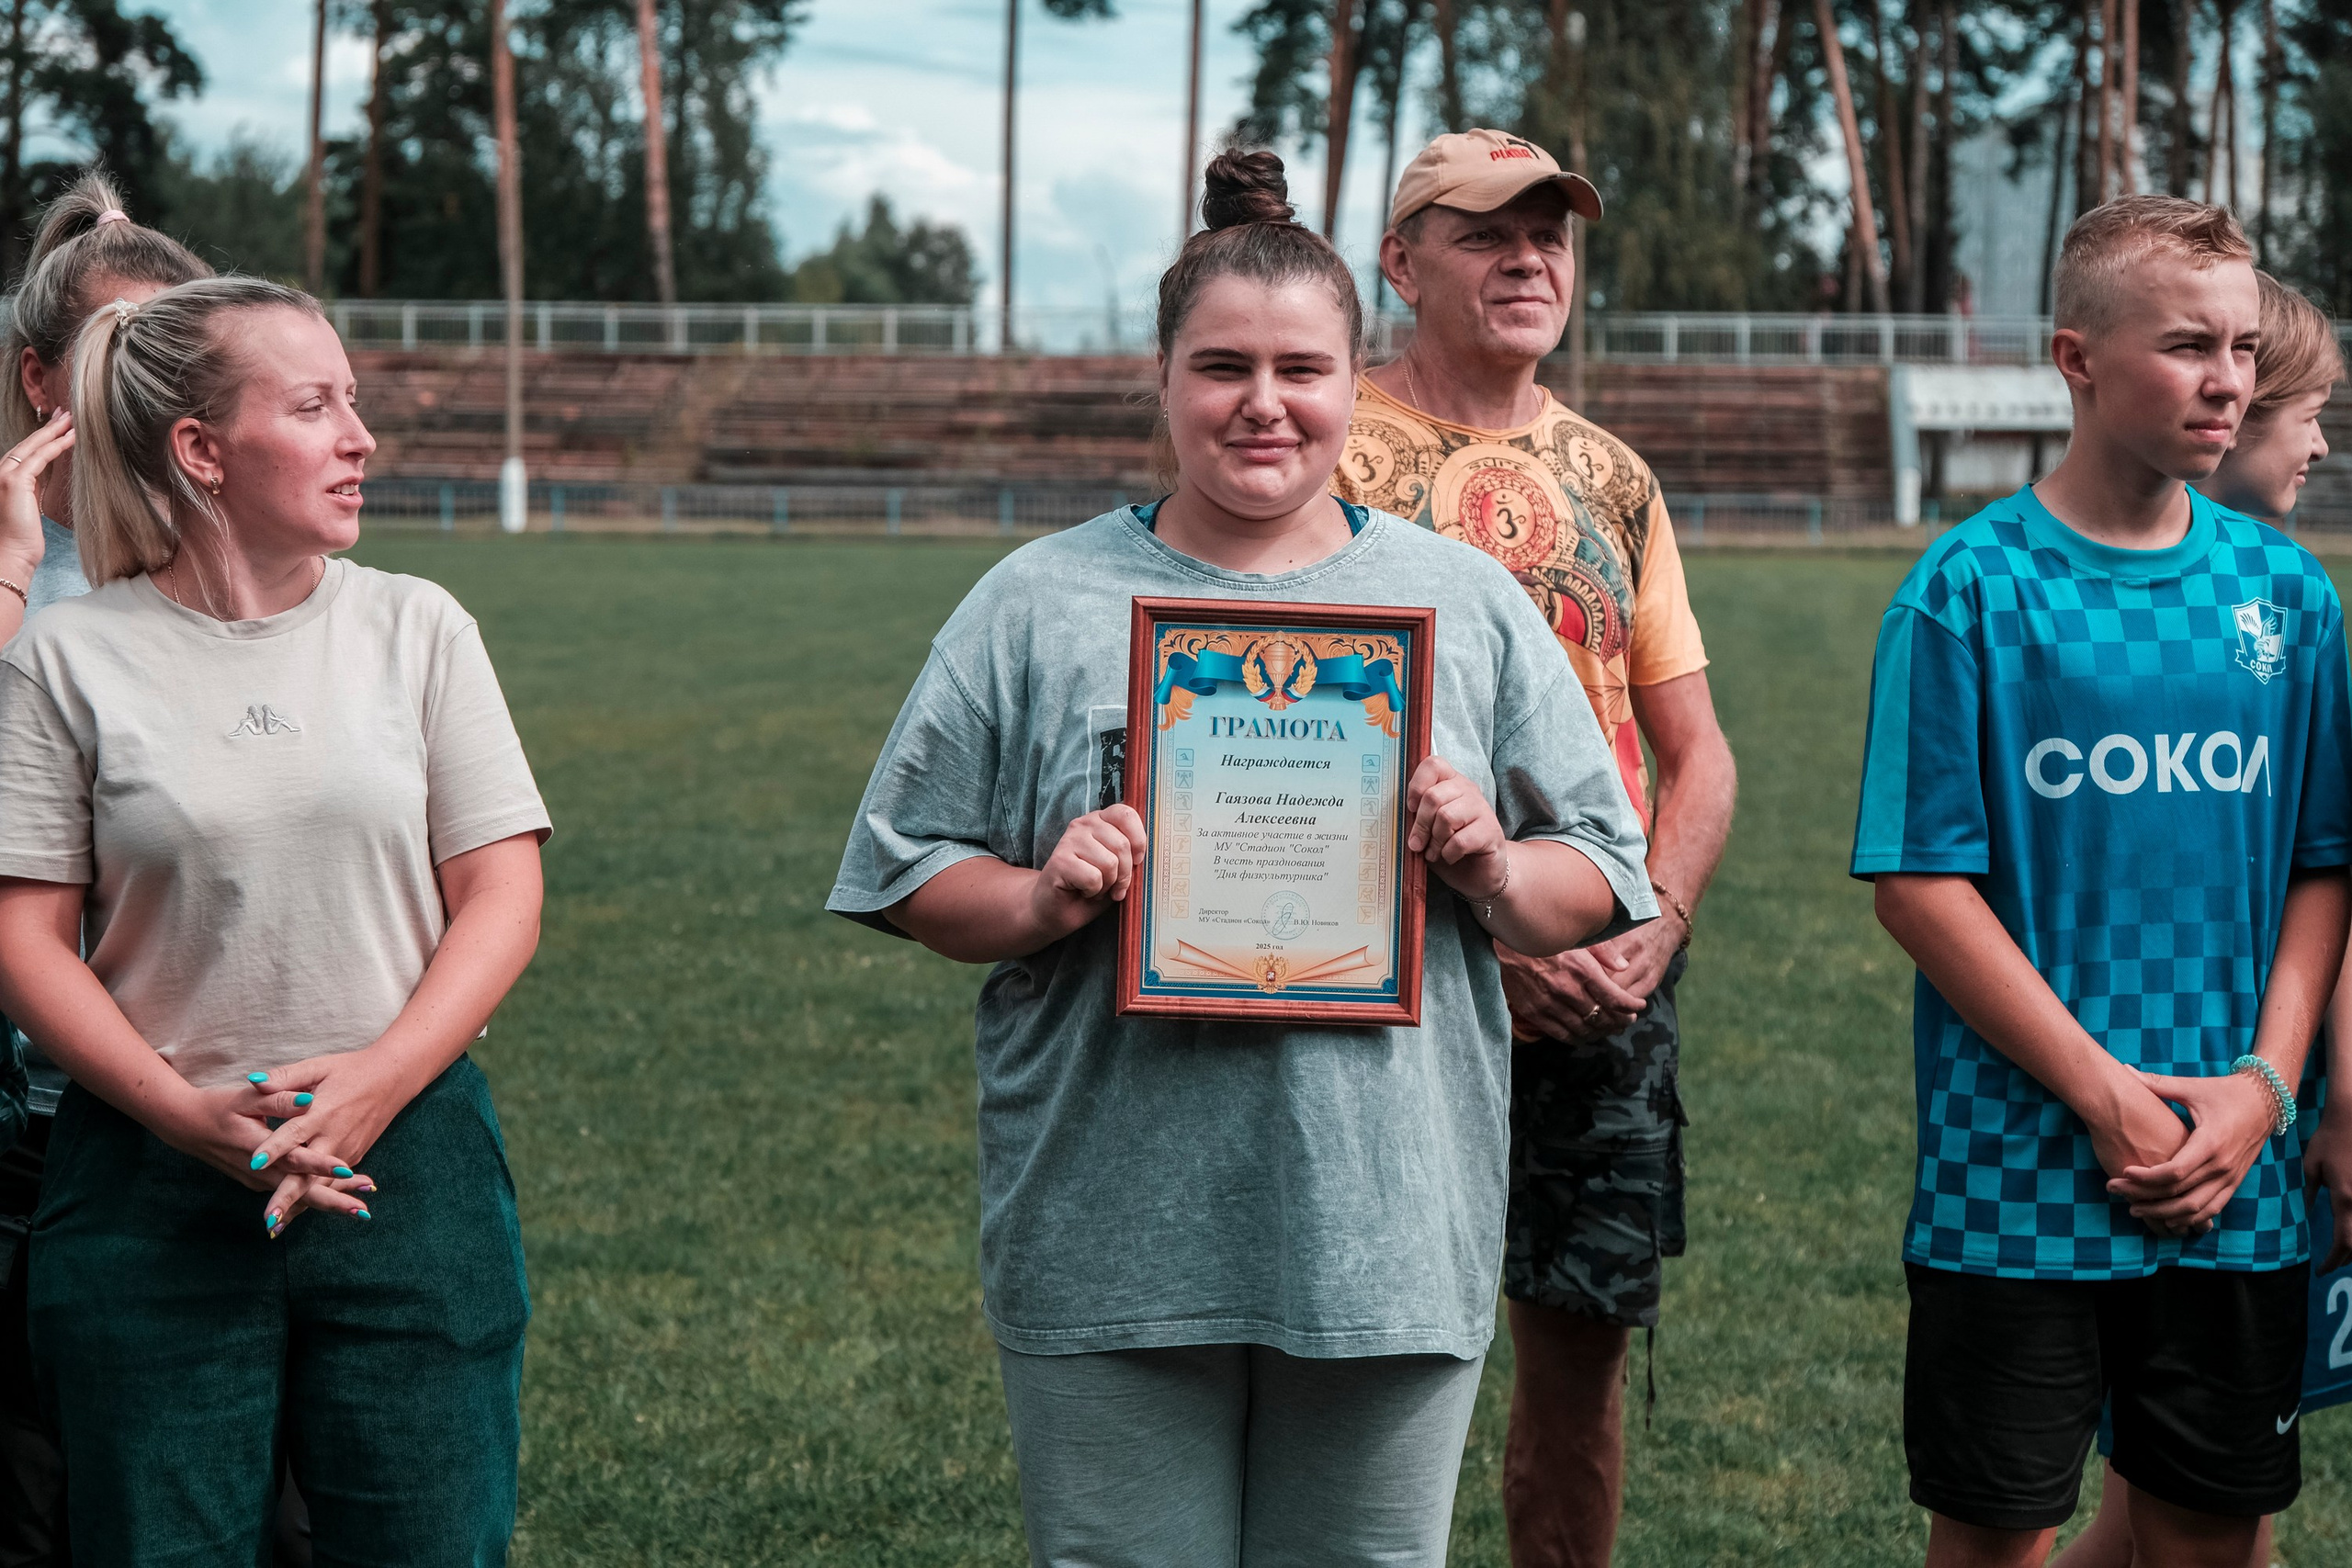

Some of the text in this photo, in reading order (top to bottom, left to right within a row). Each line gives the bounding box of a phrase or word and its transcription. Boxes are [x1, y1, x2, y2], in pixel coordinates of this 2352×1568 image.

[1208, 716, 1348, 742] ГРАМОТА
[1220, 754, 1331, 770] Награждается
[2025, 730, 2272, 799] СОКОЛ
[1215, 791, 1344, 807] Гаязова Надежда
[1235, 811, 1317, 826] Алексеевна
[1196, 828, 1349, 841] За активное участие в жизни
[1214, 841, 1329, 854] МУ "Стадион "Сокол"
[1213, 855, 1325, 868] В честь празднования
[1214, 869, 1329, 883] "Дня физкультурника"
